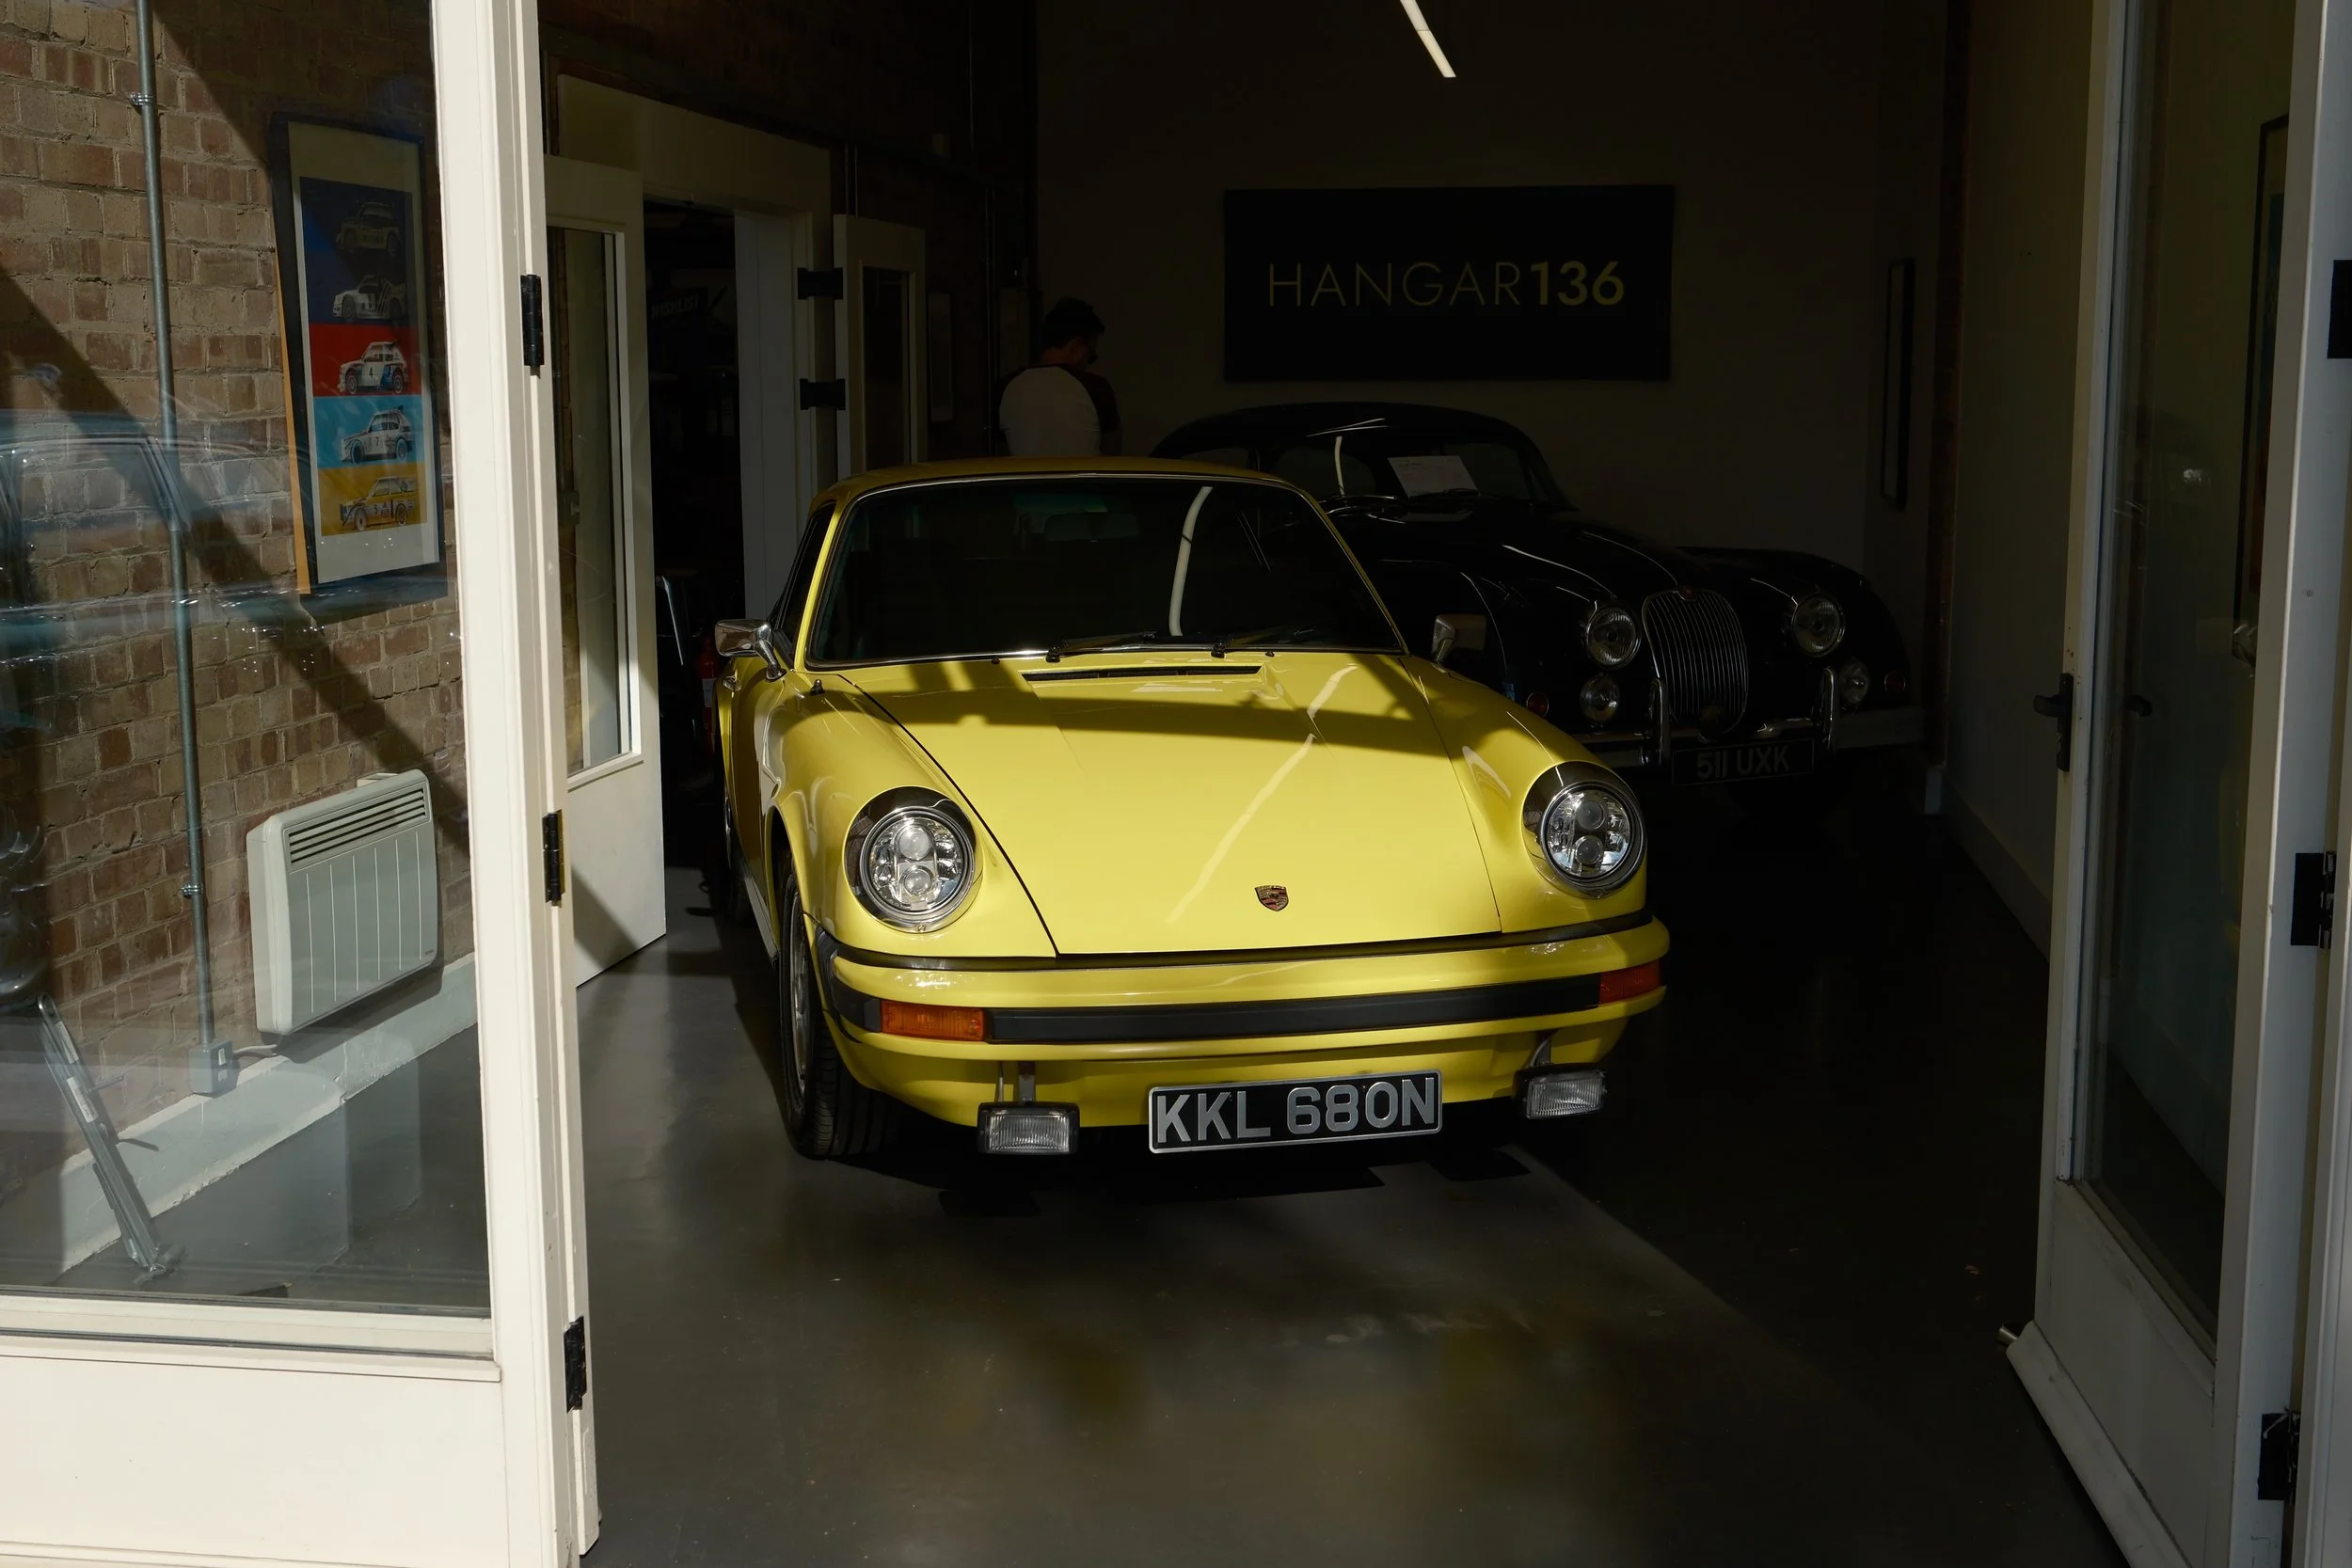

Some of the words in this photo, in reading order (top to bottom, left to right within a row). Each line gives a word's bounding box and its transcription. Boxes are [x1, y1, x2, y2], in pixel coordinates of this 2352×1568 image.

[1696, 751, 1728, 781] 511
[1736, 744, 1791, 776] UXK
[1156, 1090, 1271, 1144] KKL
[1286, 1077, 1435, 1135] 680N
